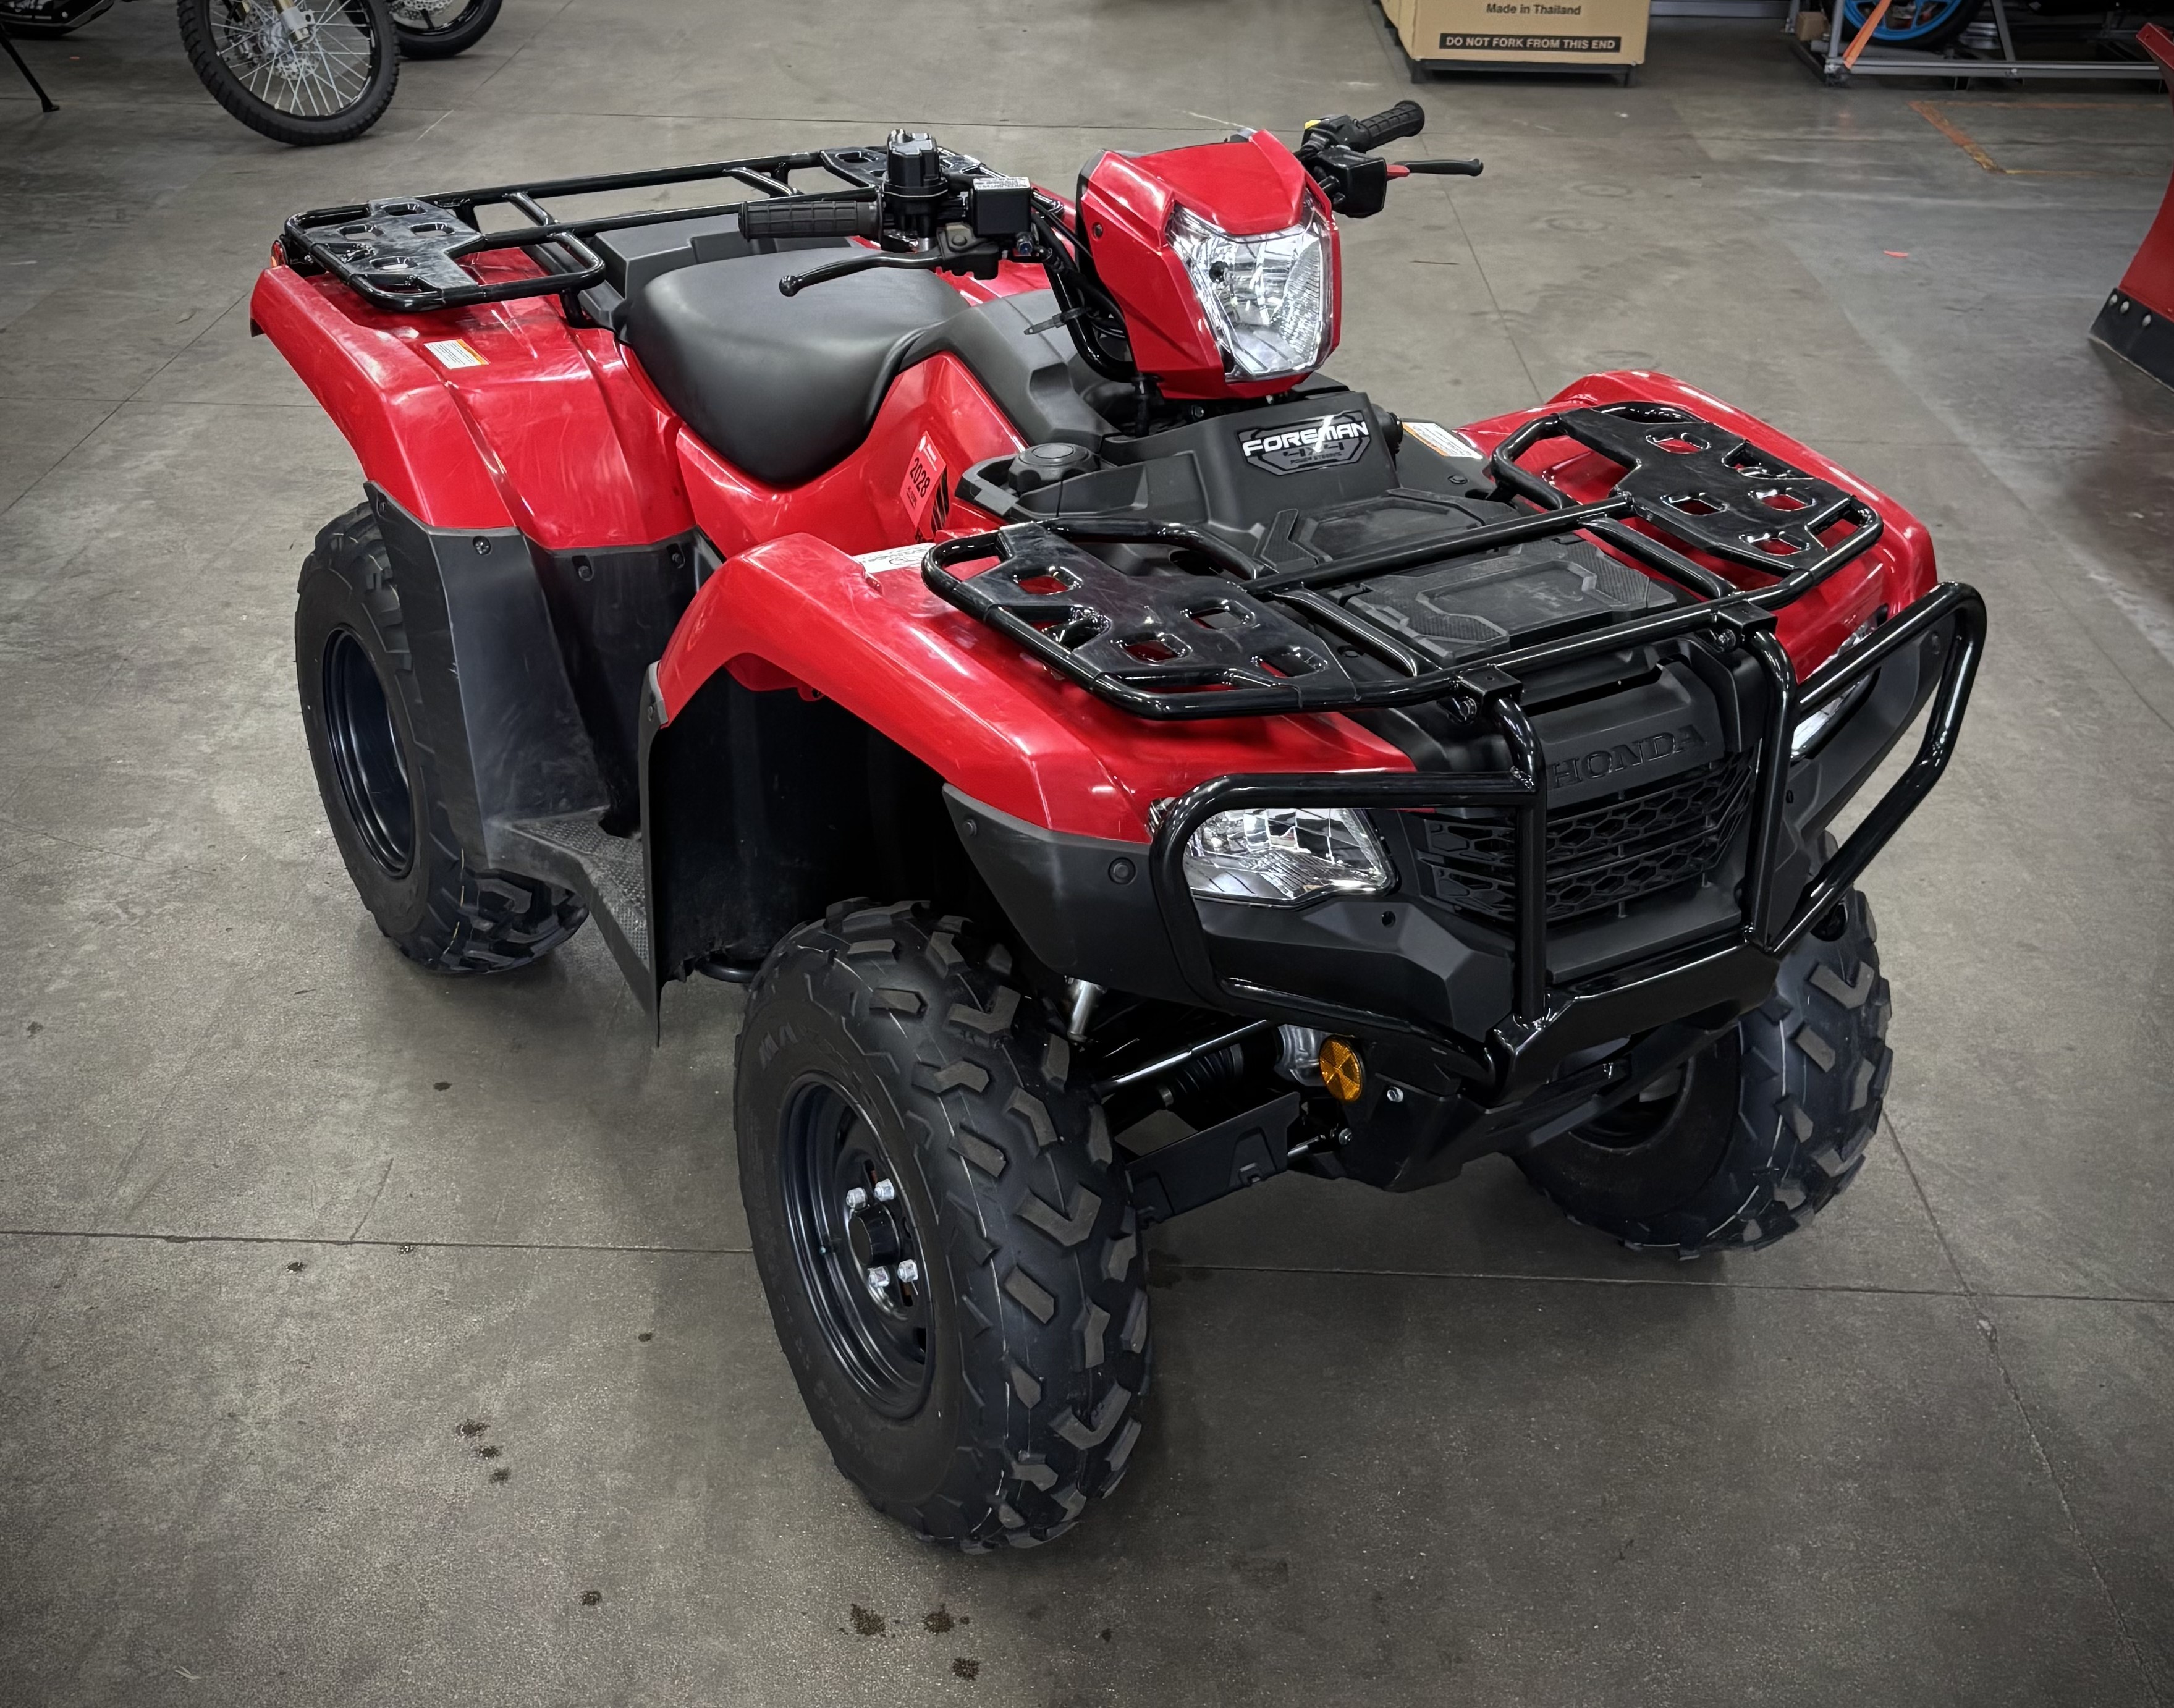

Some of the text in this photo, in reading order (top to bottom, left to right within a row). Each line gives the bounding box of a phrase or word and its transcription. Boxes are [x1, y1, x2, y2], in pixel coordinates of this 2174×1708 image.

[1486, 4, 1581, 15] Made in Thailand
[1446, 36, 1615, 49] DO NOT FORK FROM THIS END
[1242, 421, 1369, 457] FOREMAN
[1547, 724, 1706, 789] HONDA
